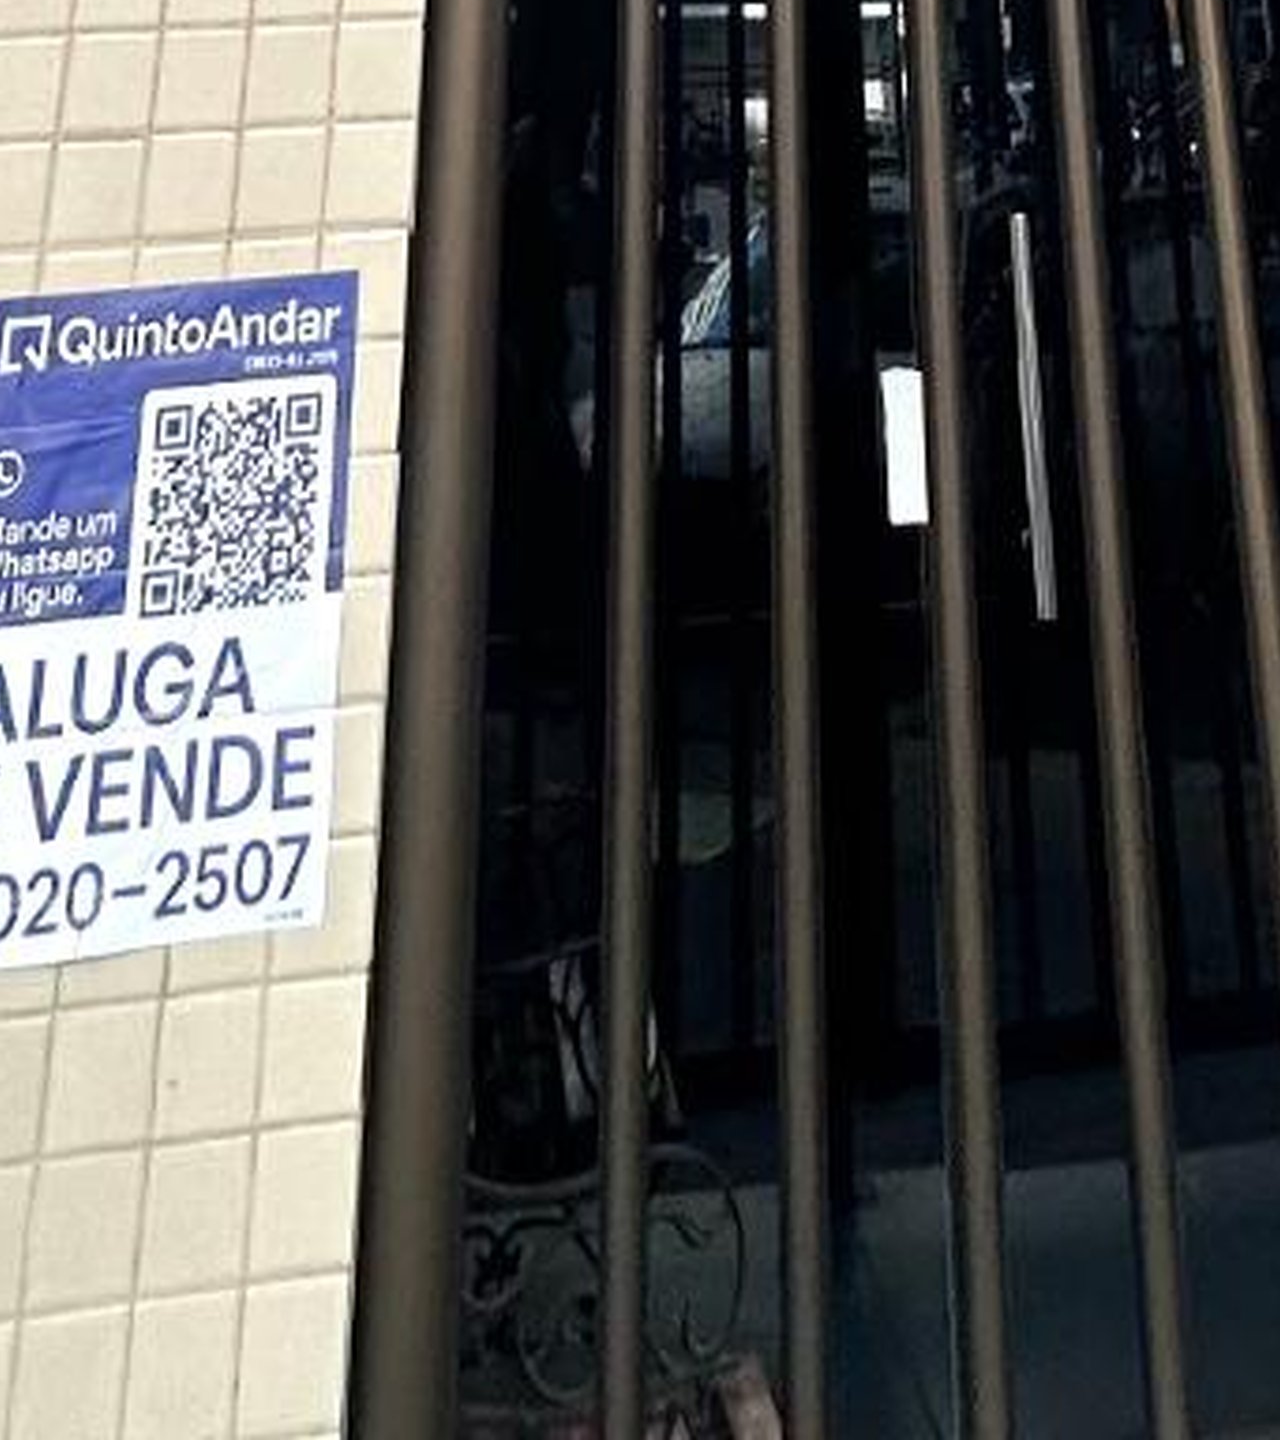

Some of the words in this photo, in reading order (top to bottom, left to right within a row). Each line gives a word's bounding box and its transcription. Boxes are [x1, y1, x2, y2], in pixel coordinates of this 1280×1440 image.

[57, 298, 342, 366] QuintoAndar
[77, 511, 117, 537] um
[11, 581, 84, 618] ligue.
[27, 726, 317, 843] VENDE
